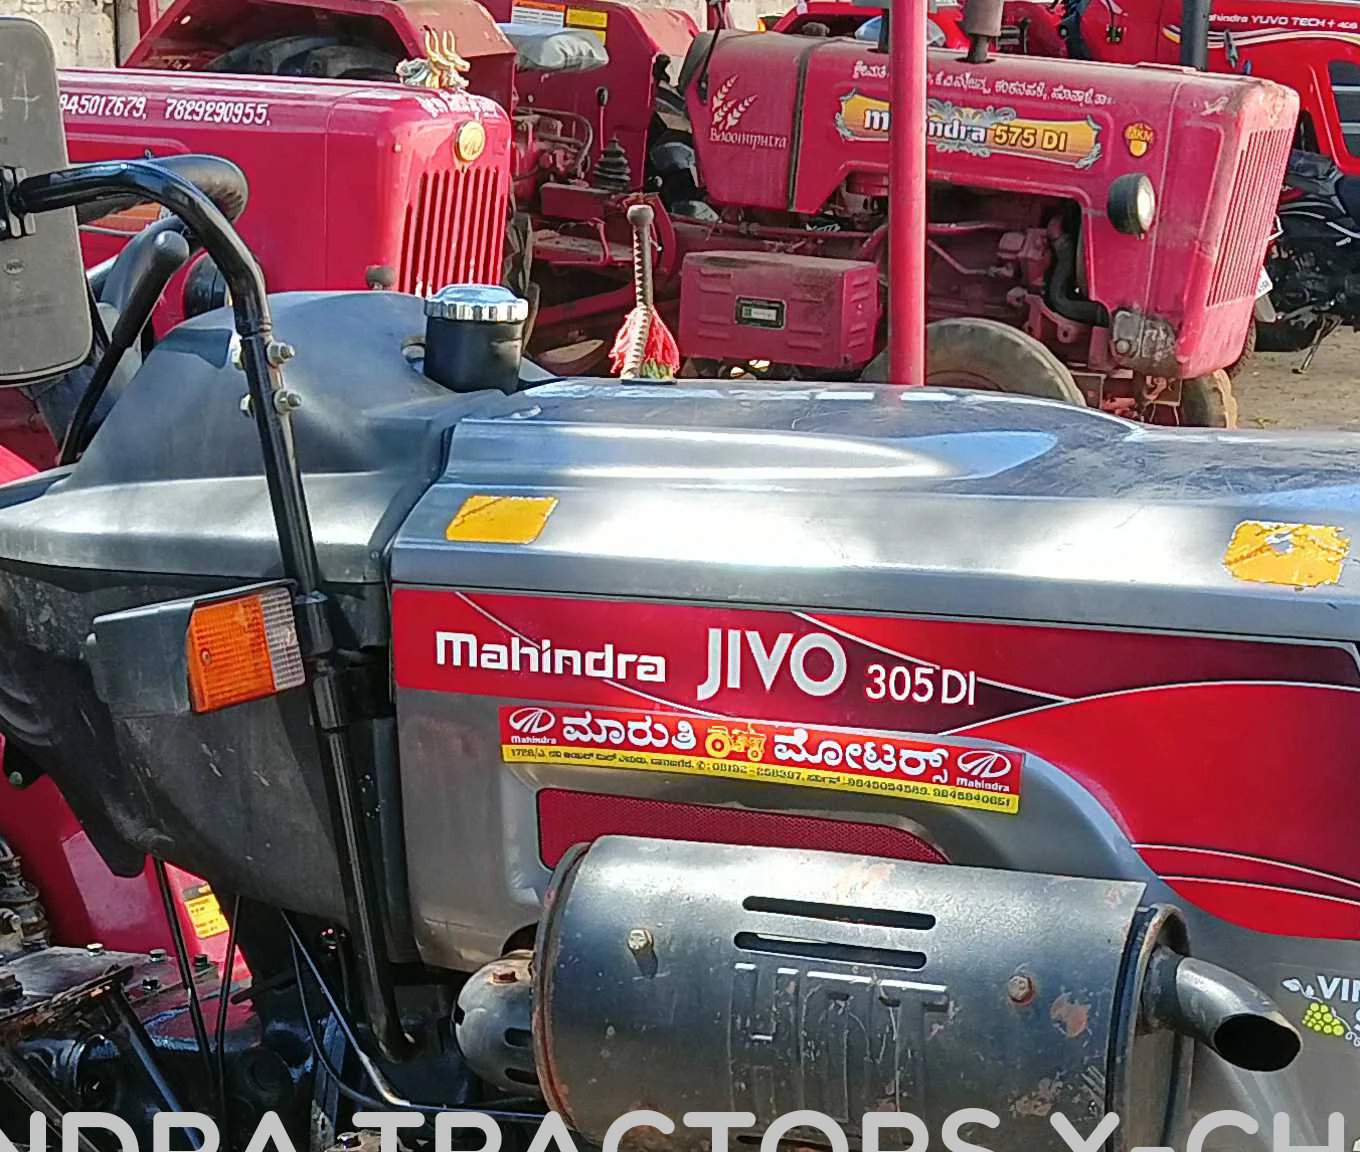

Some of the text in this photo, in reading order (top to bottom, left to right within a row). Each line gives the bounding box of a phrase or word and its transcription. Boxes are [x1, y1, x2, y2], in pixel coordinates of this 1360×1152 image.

[1251, 14, 1289, 25] YUVO
[993, 125, 1036, 149] 575
[1042, 130, 1067, 151] DI
[435, 631, 666, 684] Mahindra
[697, 627, 847, 701] JIVO
[561, 710, 698, 750] ಮಾರುತಿ
